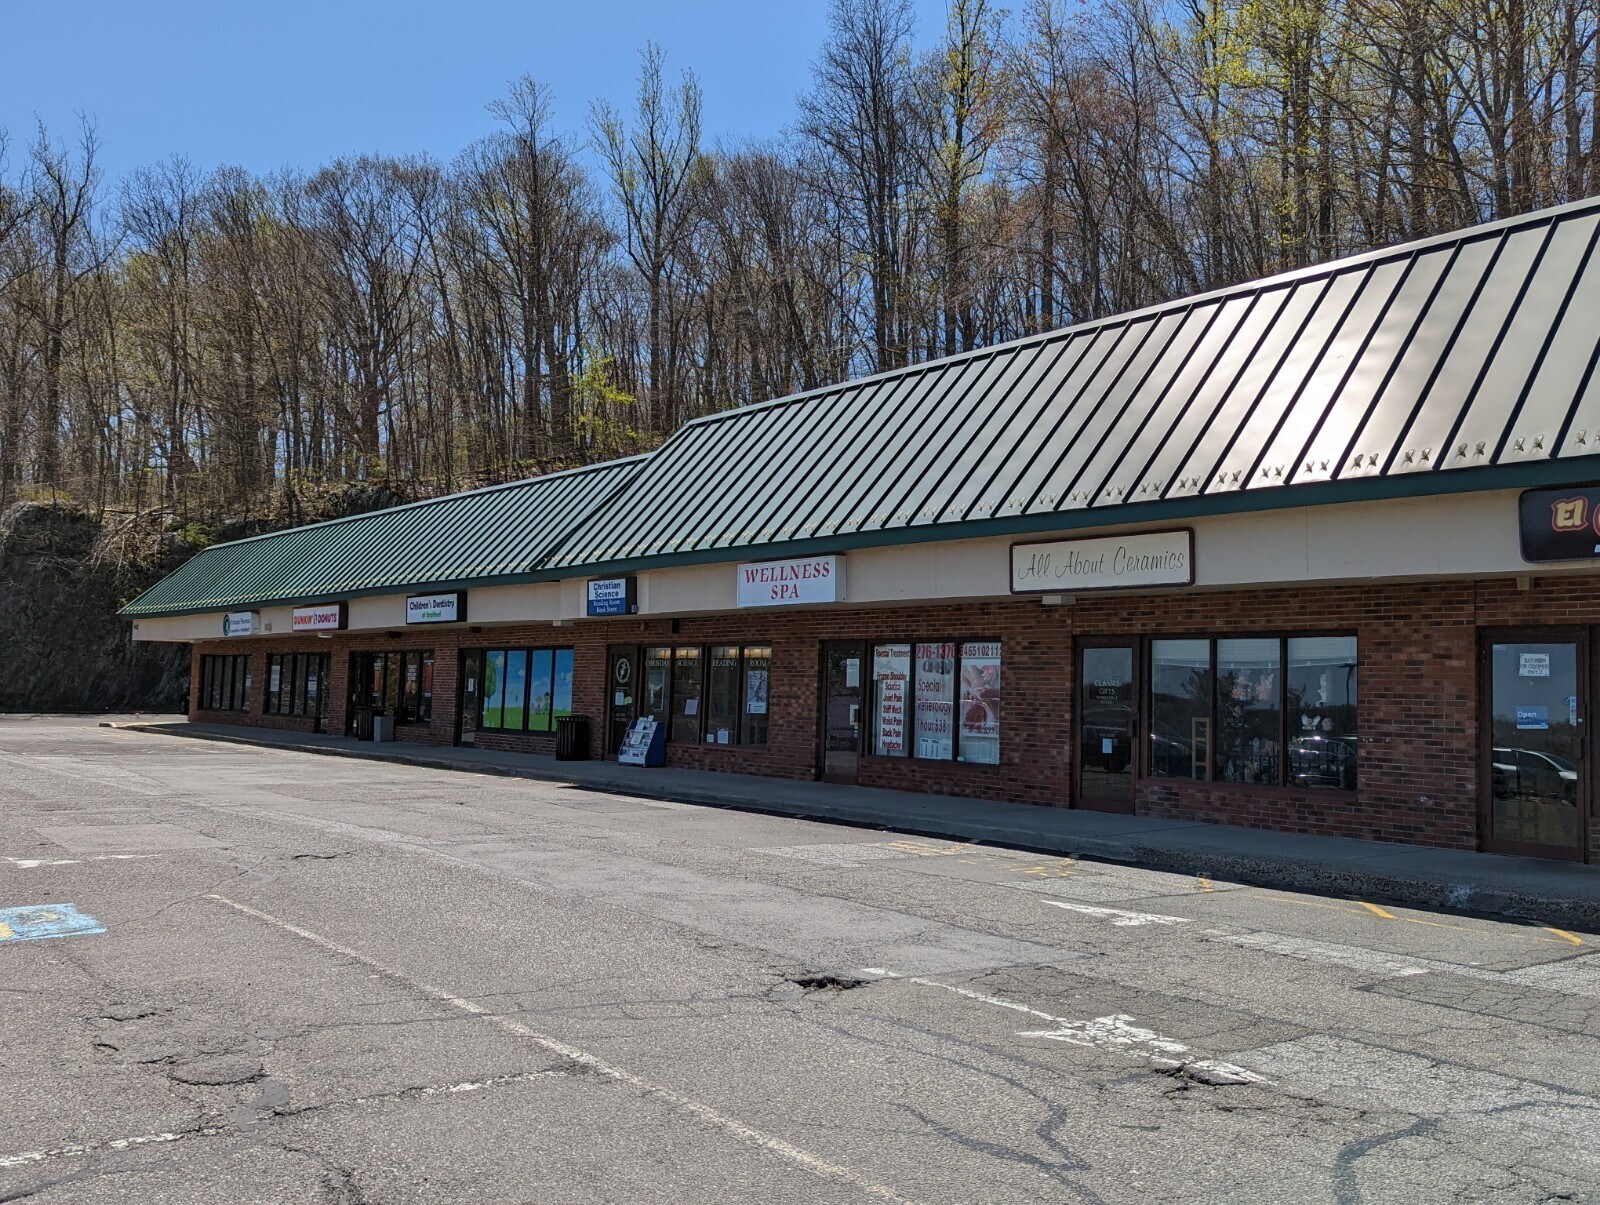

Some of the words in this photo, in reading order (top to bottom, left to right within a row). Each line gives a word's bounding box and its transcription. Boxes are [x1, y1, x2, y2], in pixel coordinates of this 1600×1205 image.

[1554, 498, 1586, 529] El
[1018, 553, 1050, 579] All
[1055, 551, 1104, 577] About
[1113, 546, 1184, 575] Ceramics
[745, 561, 830, 583] WELLNESS
[593, 581, 621, 591] Christian
[770, 583, 800, 600] SPA
[594, 590, 619, 599] Science
[410, 600, 432, 610] Children's
[433, 599, 454, 609] Dentistry
[318, 613, 337, 624] DONUTS
[645, 659, 671, 667] CHRISTIAN
[918, 679, 942, 693] Special
[1517, 711, 1537, 719] Open
